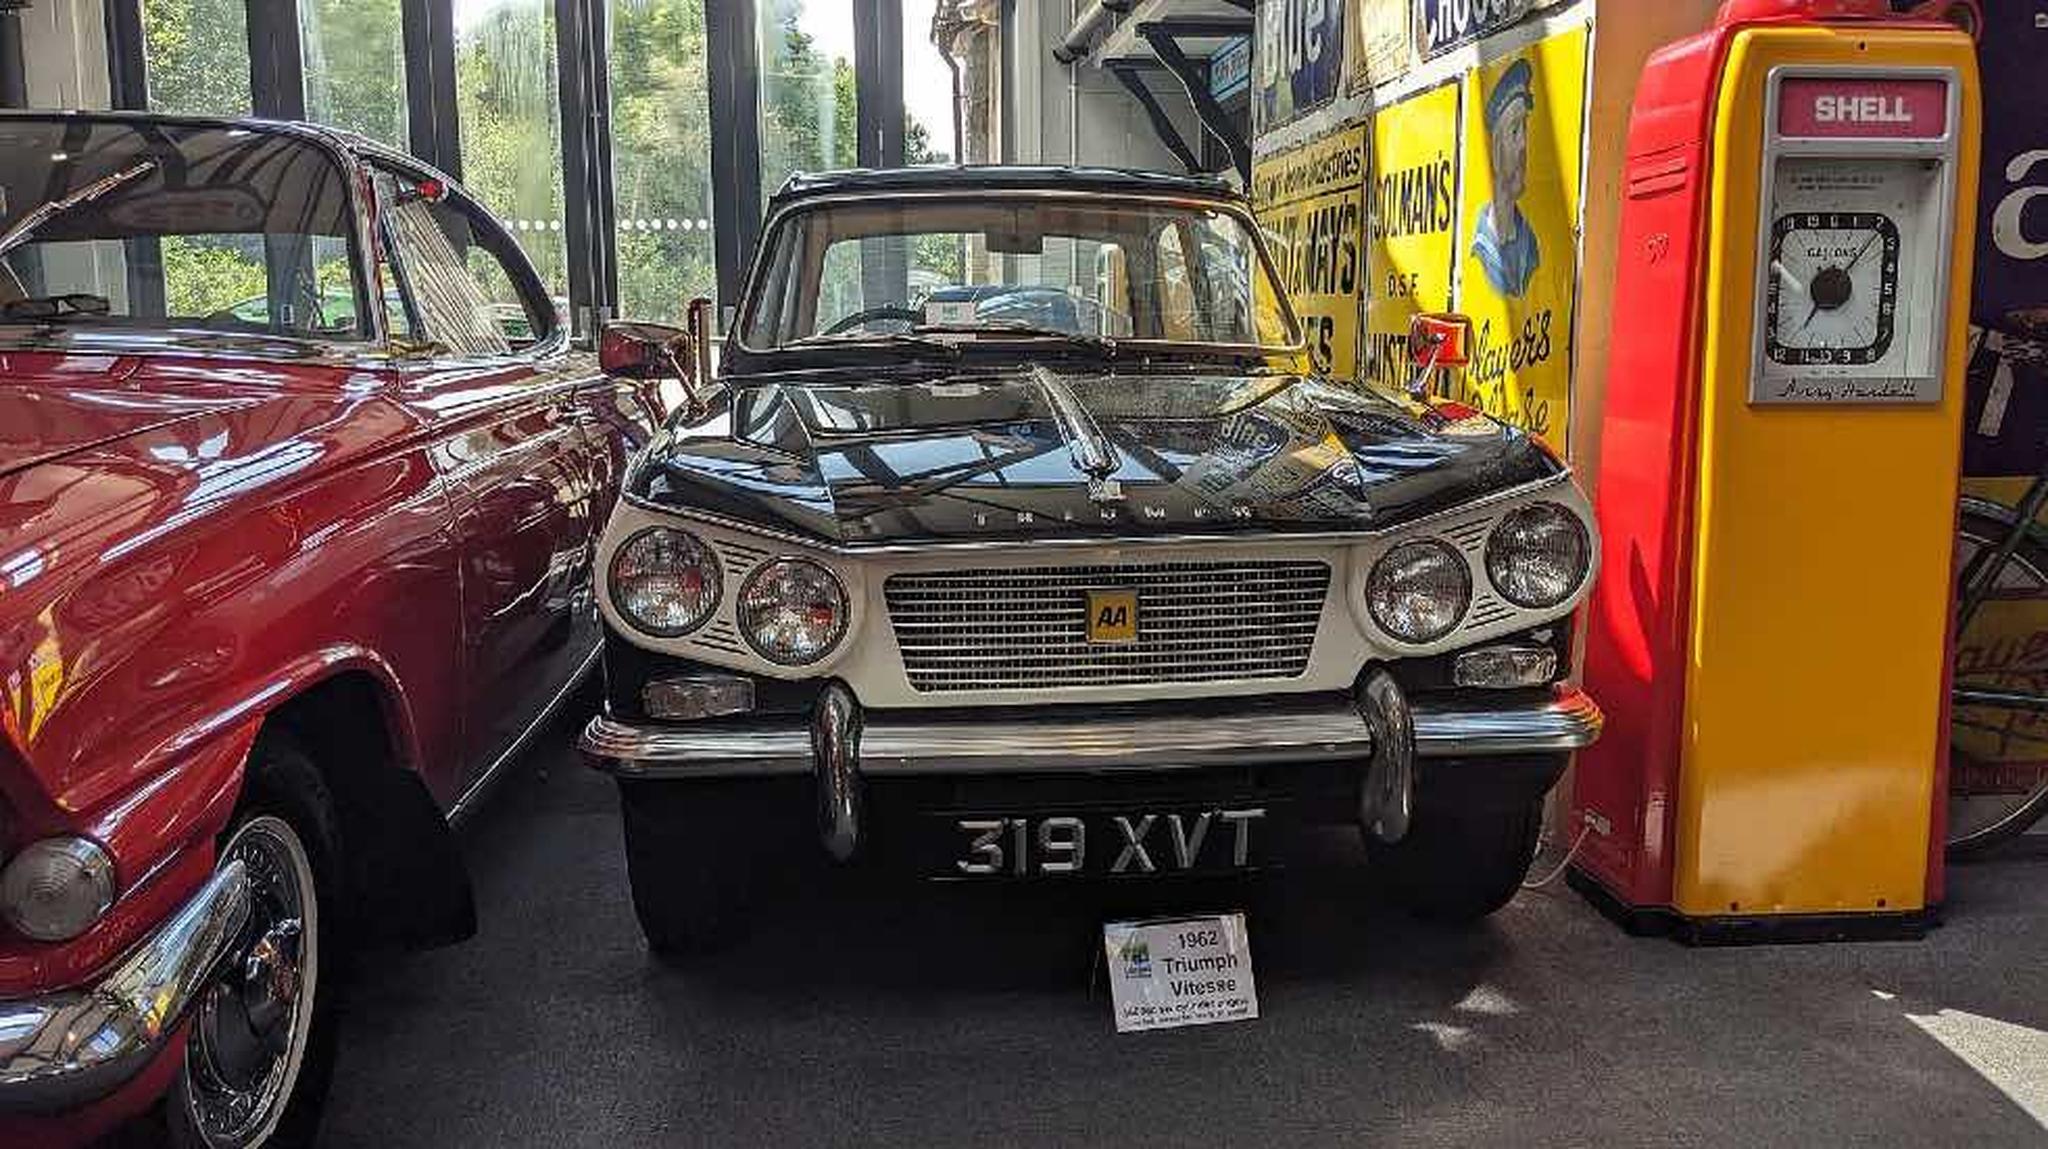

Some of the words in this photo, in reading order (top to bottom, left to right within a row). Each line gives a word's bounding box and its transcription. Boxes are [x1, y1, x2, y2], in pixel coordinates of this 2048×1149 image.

[1815, 95, 1912, 122] SHELL
[1097, 605, 1128, 628] AA
[957, 815, 1086, 875] 319
[1110, 808, 1268, 872] XVT
[1178, 930, 1219, 950] 1962
[1164, 952, 1238, 975] Triumph
[1170, 978, 1236, 998] Vitesse
